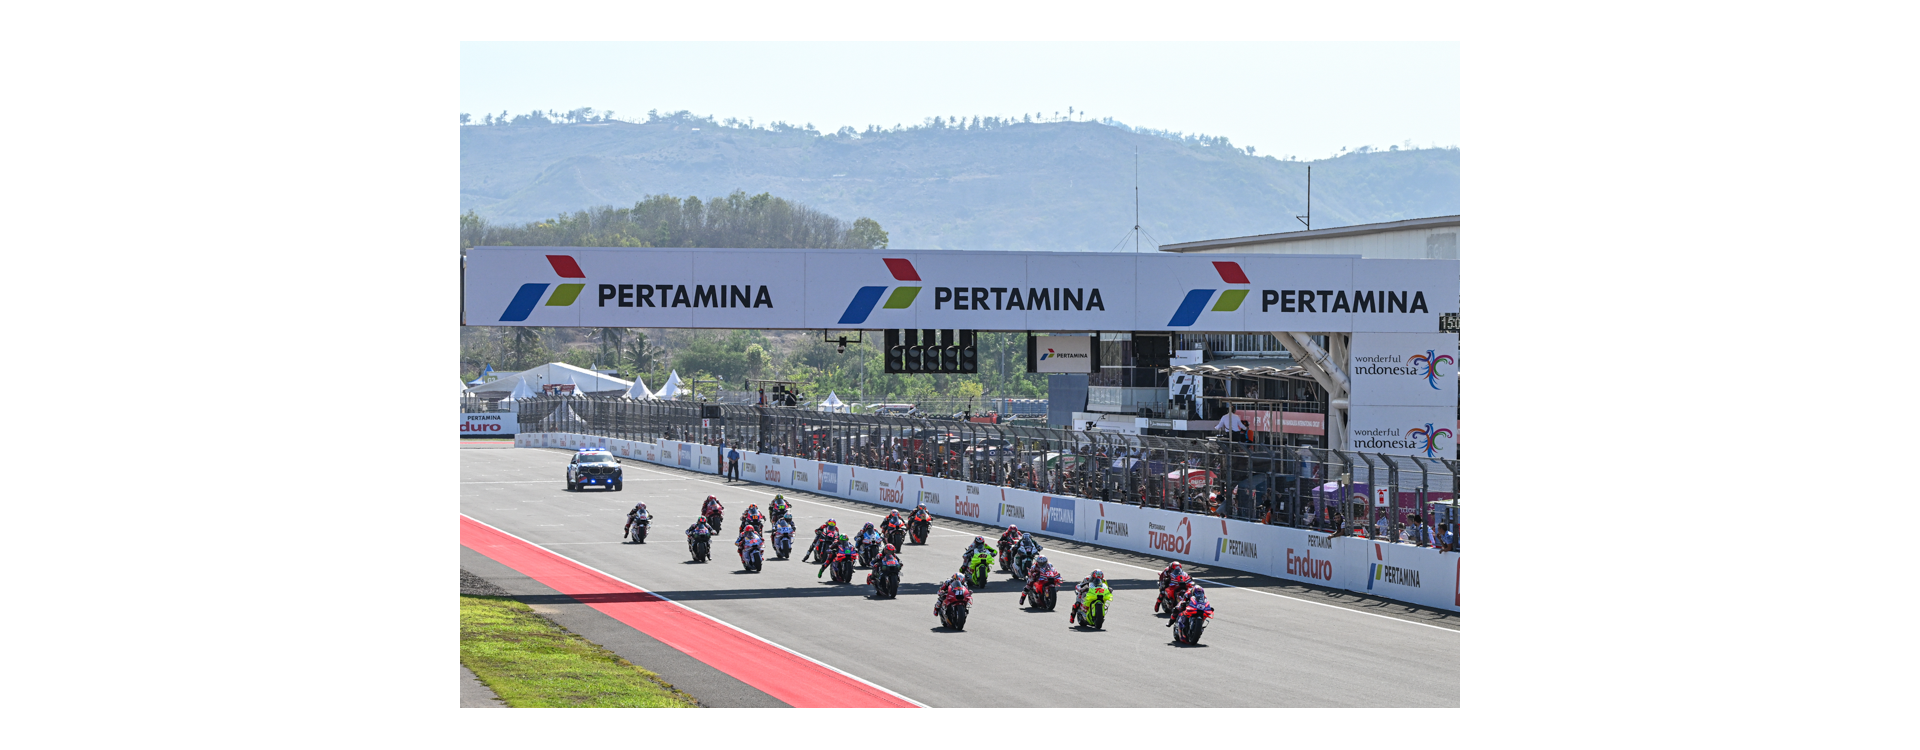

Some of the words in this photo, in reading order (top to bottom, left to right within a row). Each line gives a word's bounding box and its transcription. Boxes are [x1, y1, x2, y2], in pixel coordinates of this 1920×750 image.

[598, 284, 774, 309] PERTAMINA
[934, 286, 1105, 311] PERTAMINA
[1261, 289, 1429, 314] PERTAMINA
[1355, 355, 1402, 363] wonderful
[1355, 363, 1418, 375] indonesia
[1354, 427, 1400, 436] wonderful
[1354, 437, 1417, 449] indonesia
[879, 487, 900, 504] TURBO
[954, 495, 980, 519] Enduro
[1005, 504, 1025, 519] PERTAMINA
[1105, 520, 1129, 537] PERTAMINA
[1148, 531, 1185, 553] TURBO
[1228, 539, 1258, 559] PERTAMINA
[1308, 534, 1333, 550] PERTAMINA
[1286, 547, 1333, 581] Enduro
[1384, 565, 1421, 588] PERTAMINA
